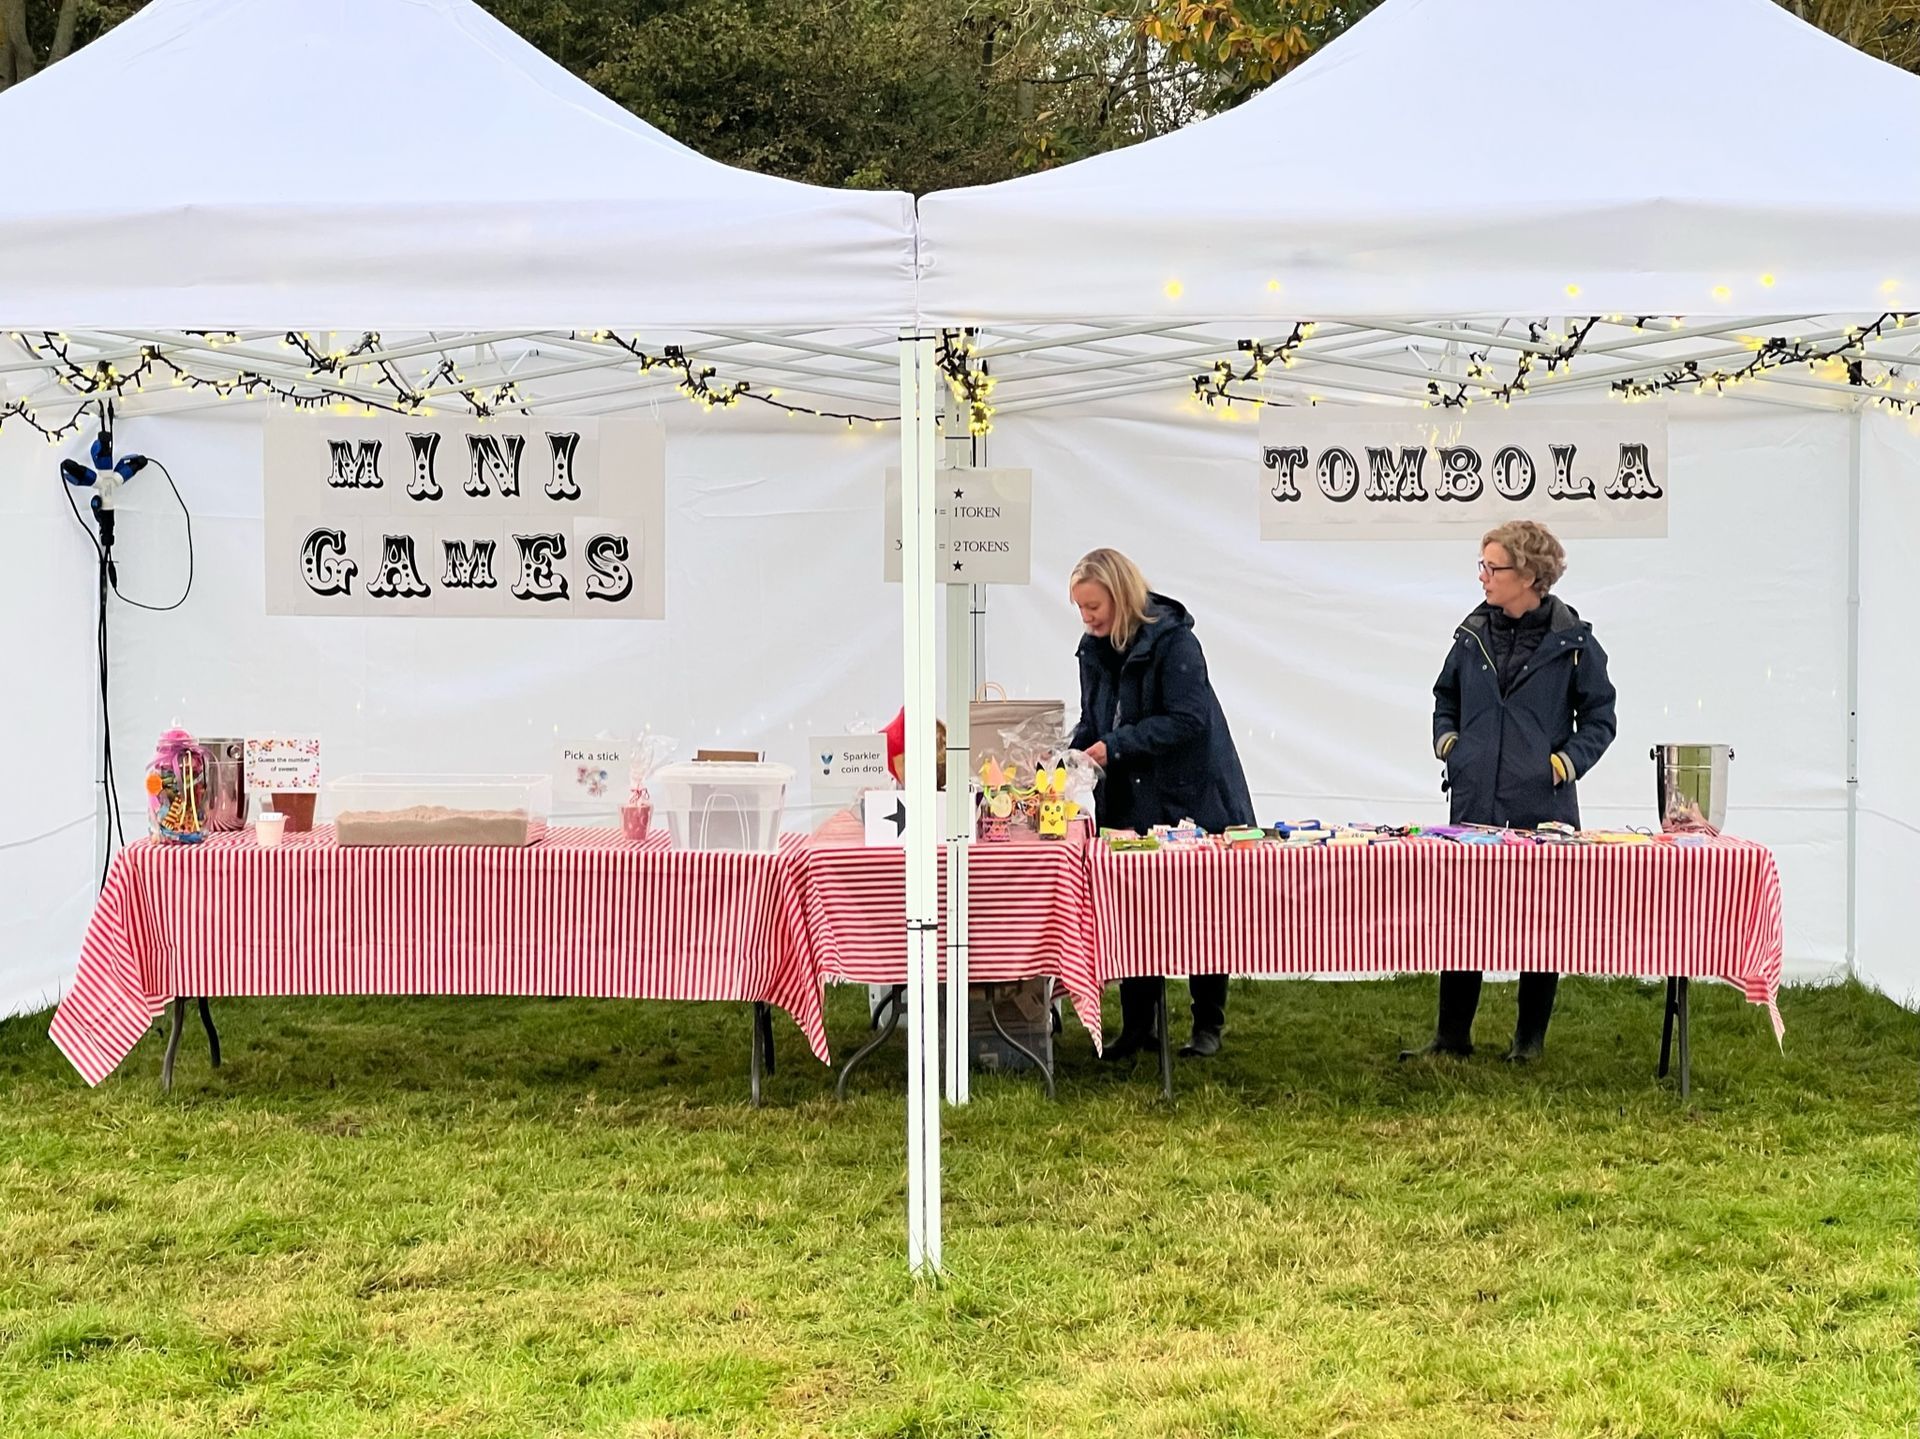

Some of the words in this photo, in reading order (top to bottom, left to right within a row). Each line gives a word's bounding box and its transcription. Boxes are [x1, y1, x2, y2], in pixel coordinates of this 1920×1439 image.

[327, 431, 582, 501] MINI
[1263, 443, 1663, 502] TOMBOLA
[960, 506, 1001, 518] TOKEN
[953, 541, 962, 552] 2
[963, 541, 1010, 552] TOKENS
[299, 527, 634, 602] GAMES
[564, 750, 585, 761] Pick
[588, 753, 594, 761] a
[597, 751, 620, 761] stick
[843, 752, 881, 762] Sparkler
[841, 765, 860, 774] coin
[862, 764, 884, 775] drop
